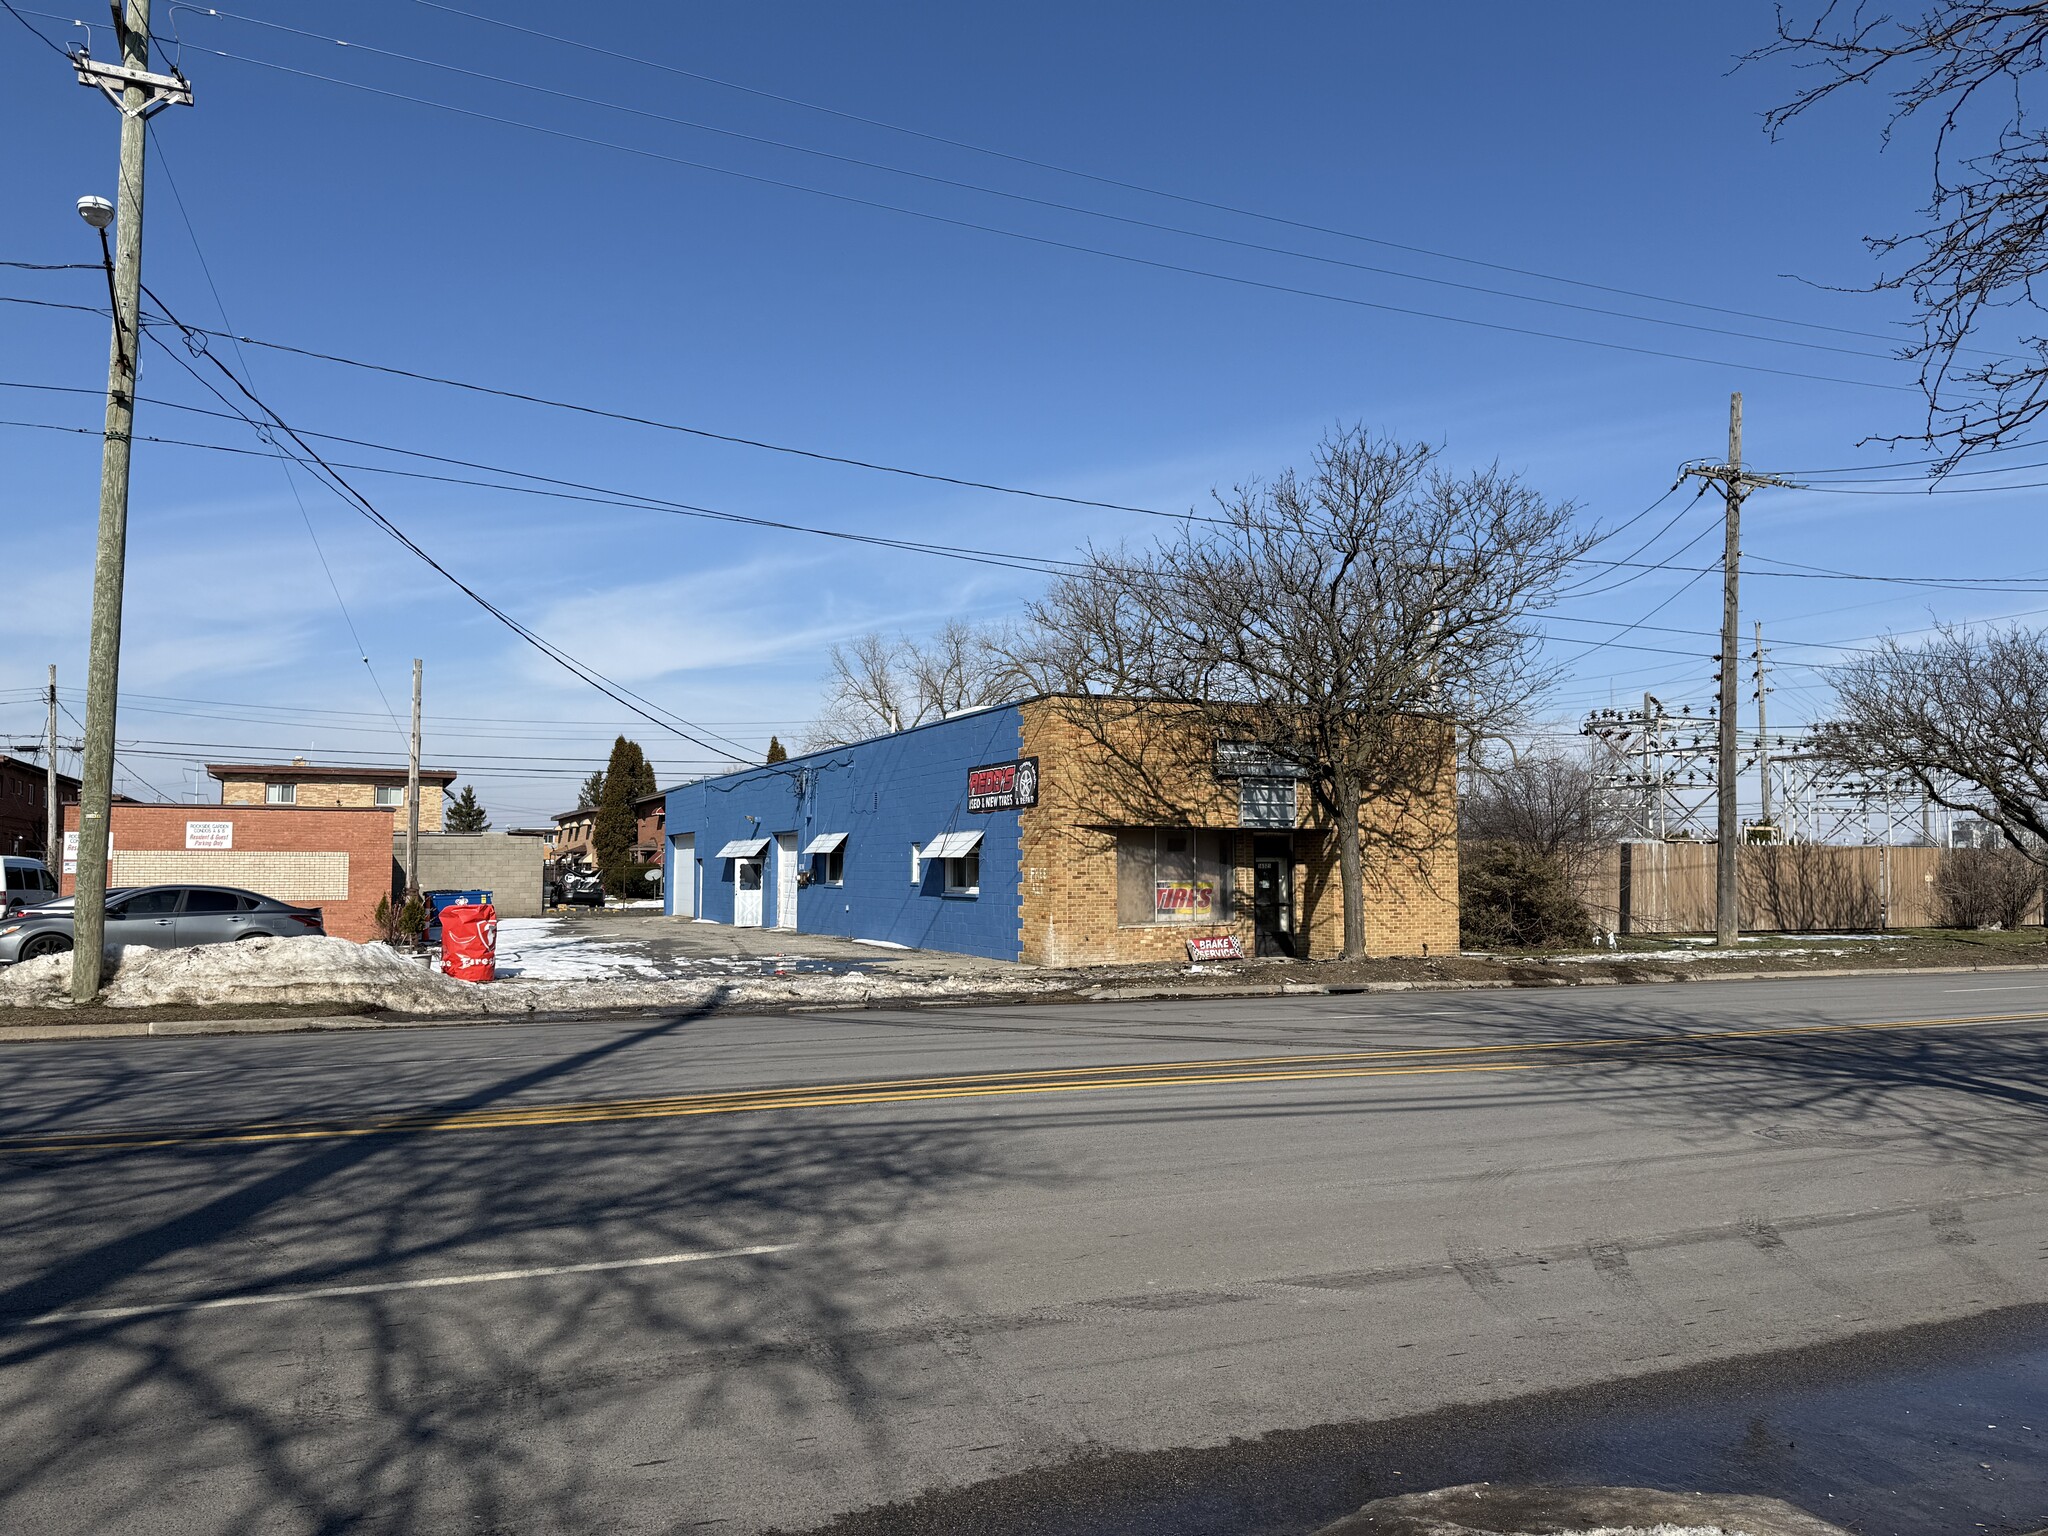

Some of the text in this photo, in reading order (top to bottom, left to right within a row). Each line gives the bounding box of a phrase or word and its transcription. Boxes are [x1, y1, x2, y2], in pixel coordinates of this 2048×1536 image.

[969, 798, 981, 809] USED
[985, 796, 999, 808] NEW
[999, 794, 1013, 806] TIRES
[1199, 938, 1229, 949] BRAKE
[1199, 948, 1236, 960] SERVICE
